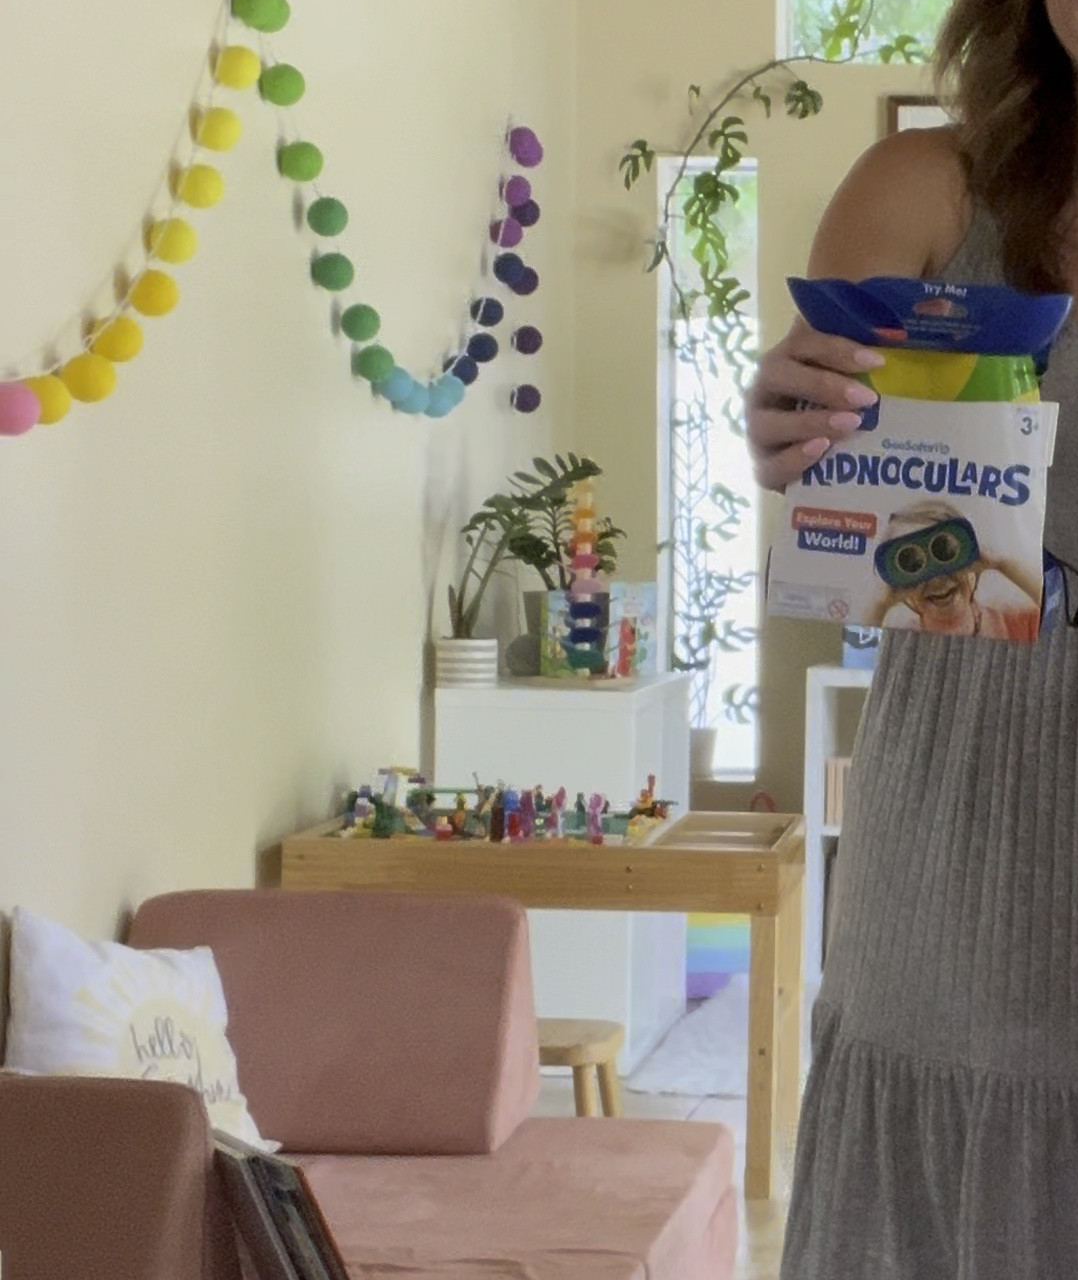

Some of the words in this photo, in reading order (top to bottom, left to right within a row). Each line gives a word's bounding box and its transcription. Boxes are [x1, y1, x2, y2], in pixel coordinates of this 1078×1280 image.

[923, 283, 941, 296] Try
[945, 283, 968, 297] Me!
[802, 452, 1031, 506] KIDNOCULARS
[804, 531, 860, 551] World!
